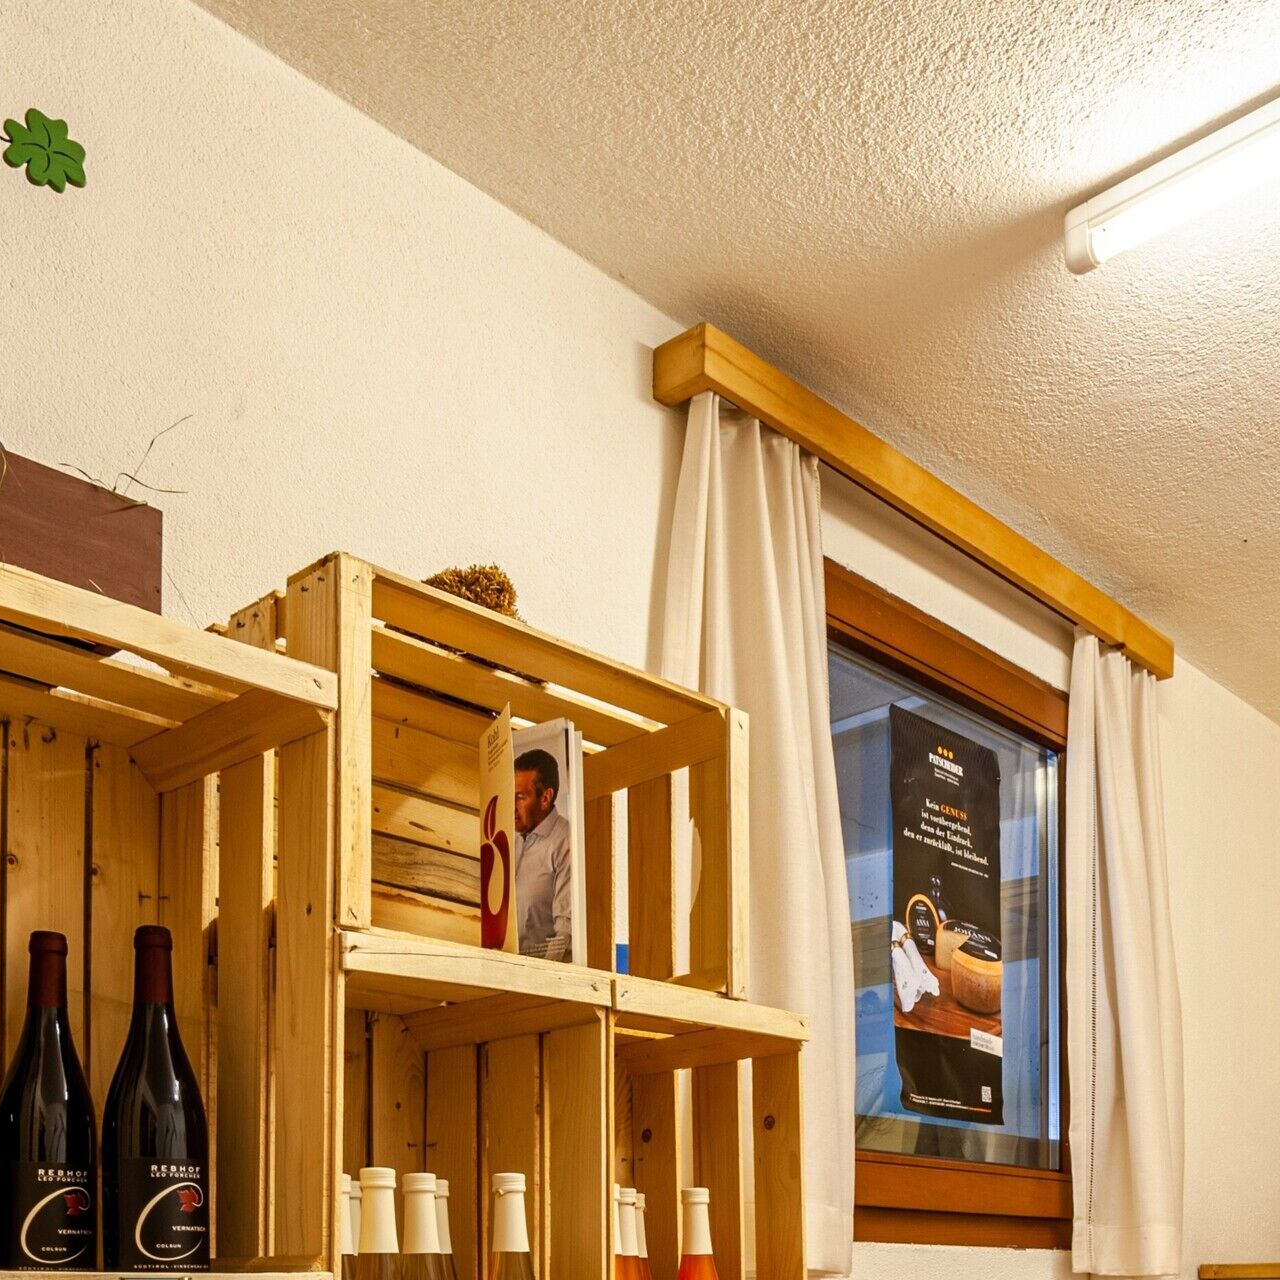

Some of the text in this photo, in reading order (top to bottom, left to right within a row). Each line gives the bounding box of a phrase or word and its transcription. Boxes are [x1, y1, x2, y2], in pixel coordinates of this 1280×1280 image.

[928, 752, 964, 776] PATSCHEIDER
[925, 798, 968, 821] Kein GENUSS
[38, 1168, 89, 1177] REBHOF
[150, 1164, 201, 1173] REBHOF
